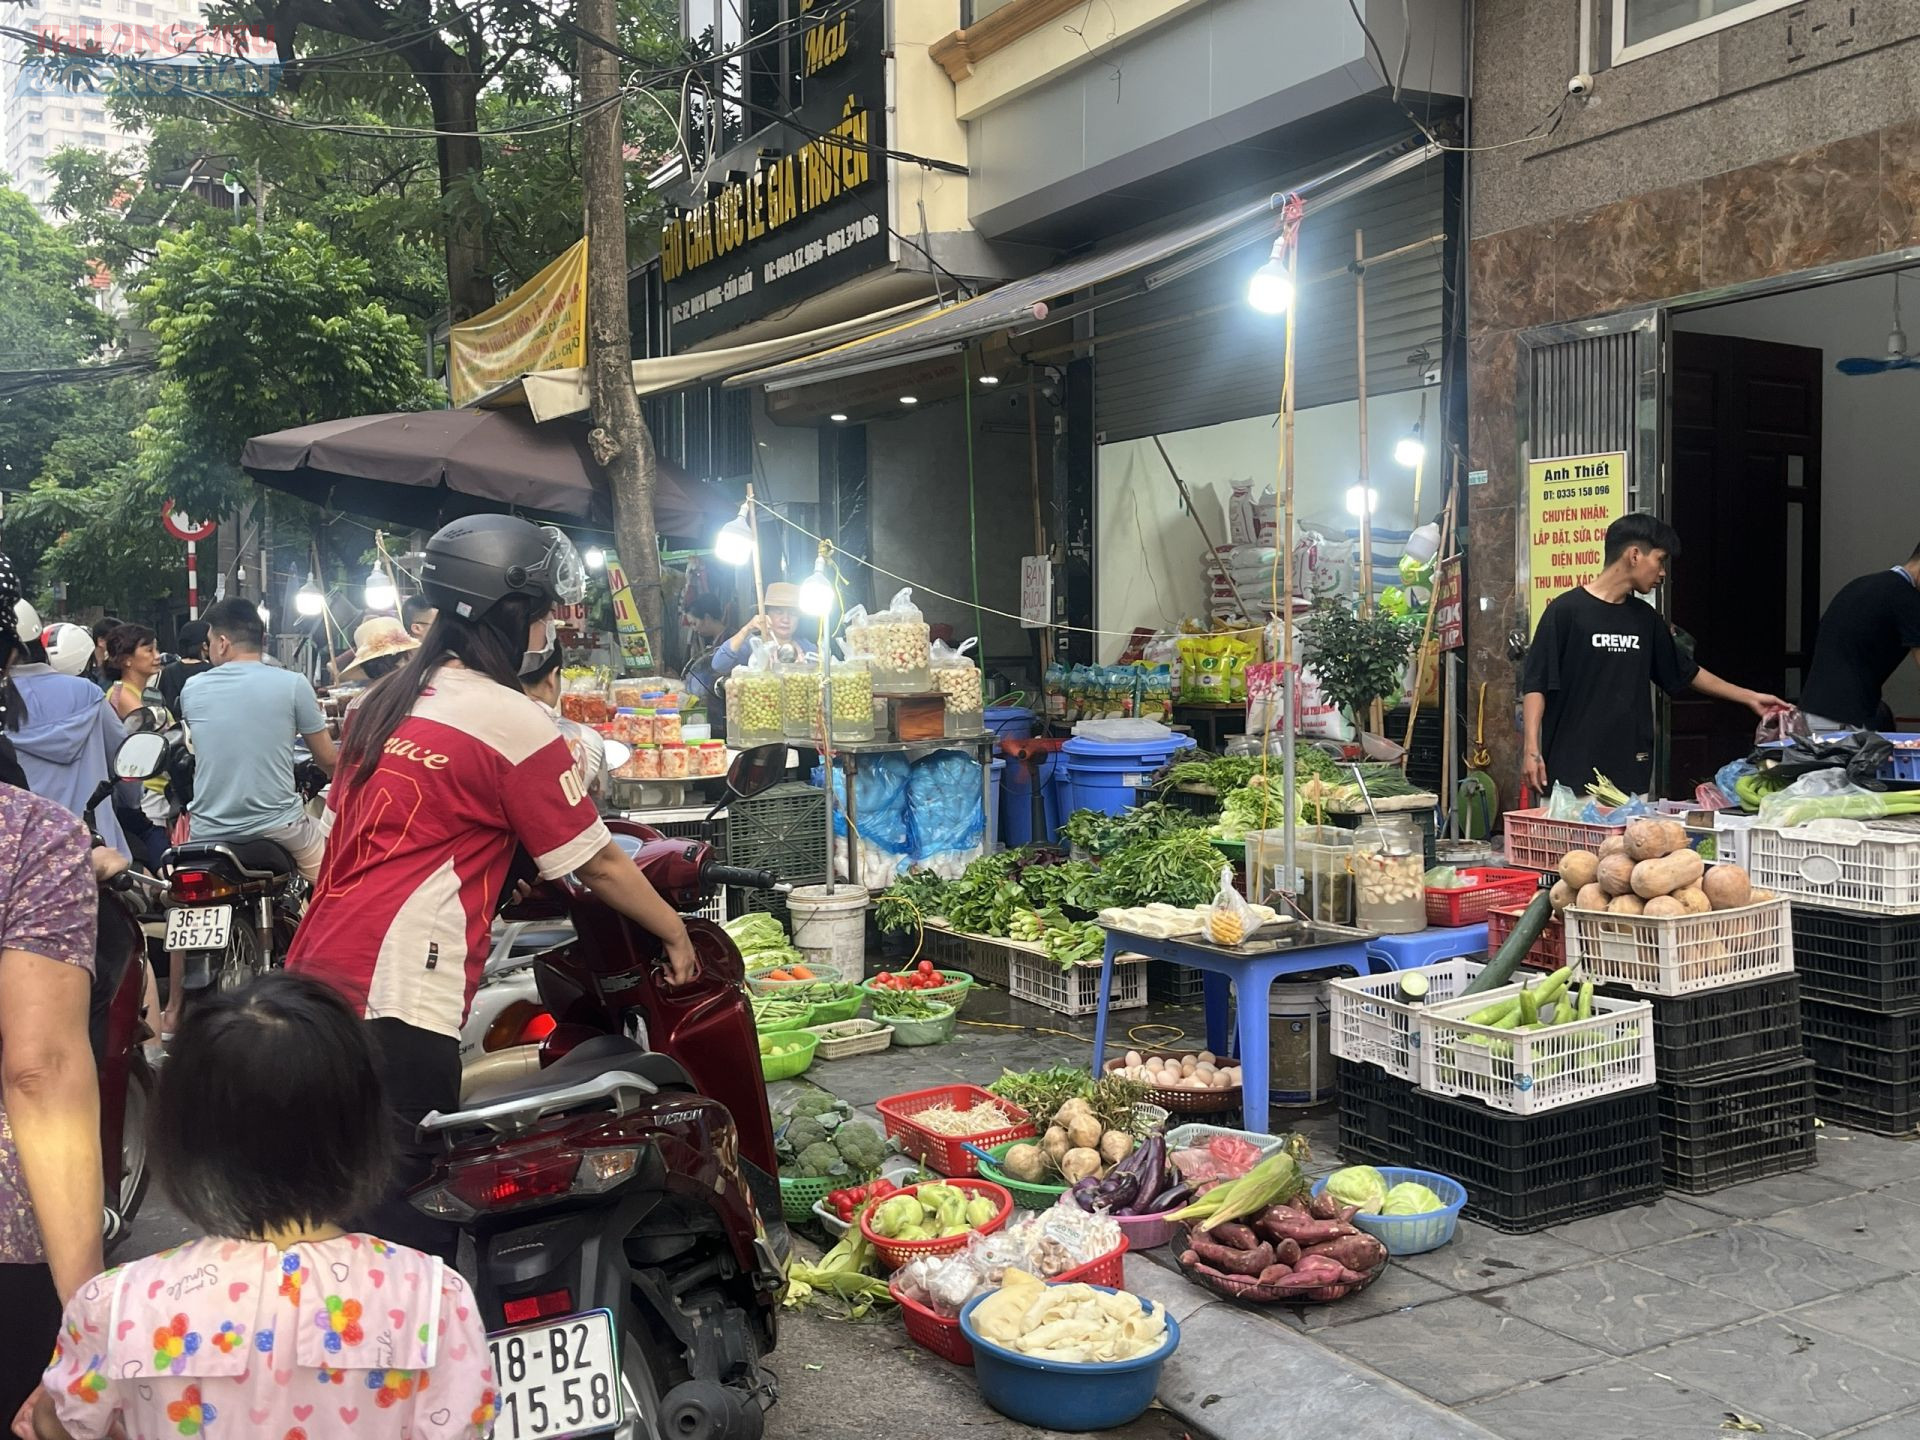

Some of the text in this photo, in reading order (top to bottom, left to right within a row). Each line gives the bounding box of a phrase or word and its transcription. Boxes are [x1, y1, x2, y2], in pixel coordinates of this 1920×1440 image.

[805, 11, 848, 78] Mai
[768, 154, 797, 231] GIA
[1544, 460, 1609, 482] Anh Thiết
[1543, 484, 1610, 501] ĐT: 0335 158 096
[1542, 503, 1609, 524] CHUYÊN NHẬN:
[1533, 531, 1550, 546] LẮP
[1552, 530, 1571, 547] ĐẶT,
[1573, 525, 1592, 542] SỬA
[1551, 550, 1600, 568] ĐIỆN NƯỚC
[1535, 576, 1550, 589] THU
[1553, 573, 1573, 588] MUA
[1592, 634, 1640, 649] CREWZ
[176, 908, 220, 928] 36-E1
[168, 927, 224, 948] 365.75
[653, 1108, 703, 1127] VISION
[489, 1323, 592, 1387] 18-B2
